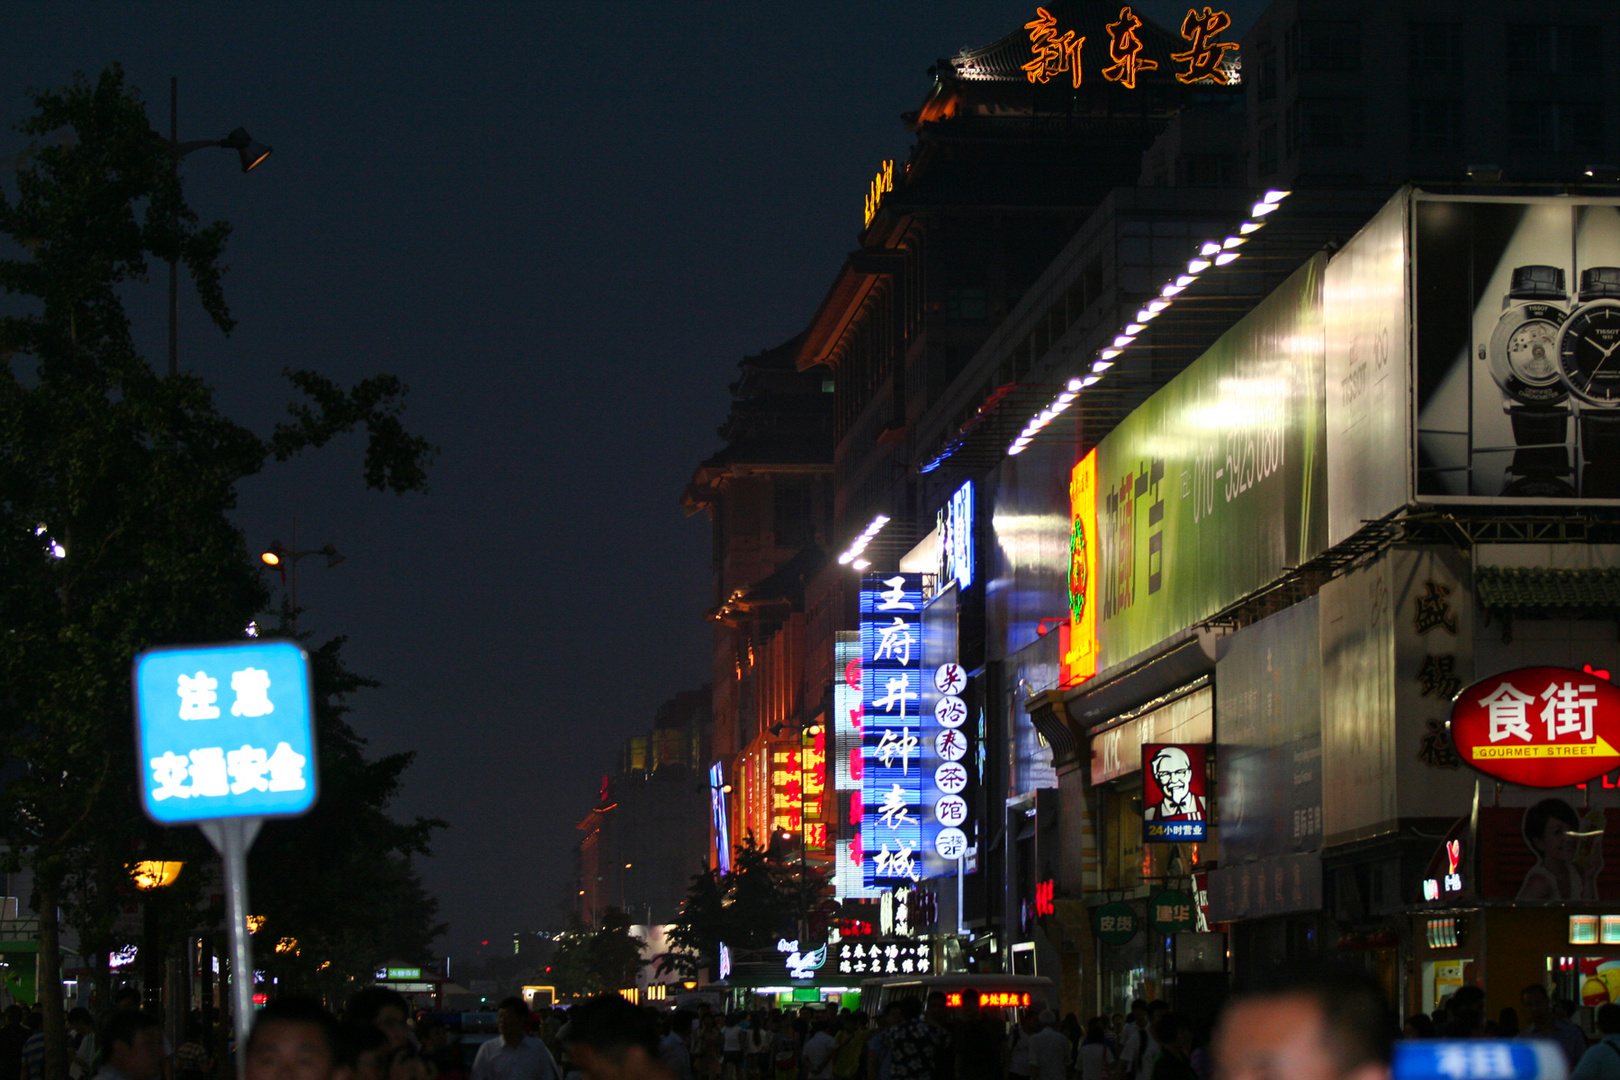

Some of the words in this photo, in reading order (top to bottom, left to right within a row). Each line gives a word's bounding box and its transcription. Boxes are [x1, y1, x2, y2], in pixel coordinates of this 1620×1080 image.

[177, 666, 274, 720] 注意
[1478, 681, 1598, 743] 食街
[871, 575, 922, 884] 王府井钟表城
[938, 663, 966, 820] 吴裕泰茶馆
[1104, 729, 1122, 775] KFC
[1479, 745, 1540, 757] GOURMET
[1546, 744, 1596, 756] STREET
[150, 741, 306, 801] 交通安全
[943, 845, 961, 855] 2F
[1148, 824, 1203, 836] 24小时营业
